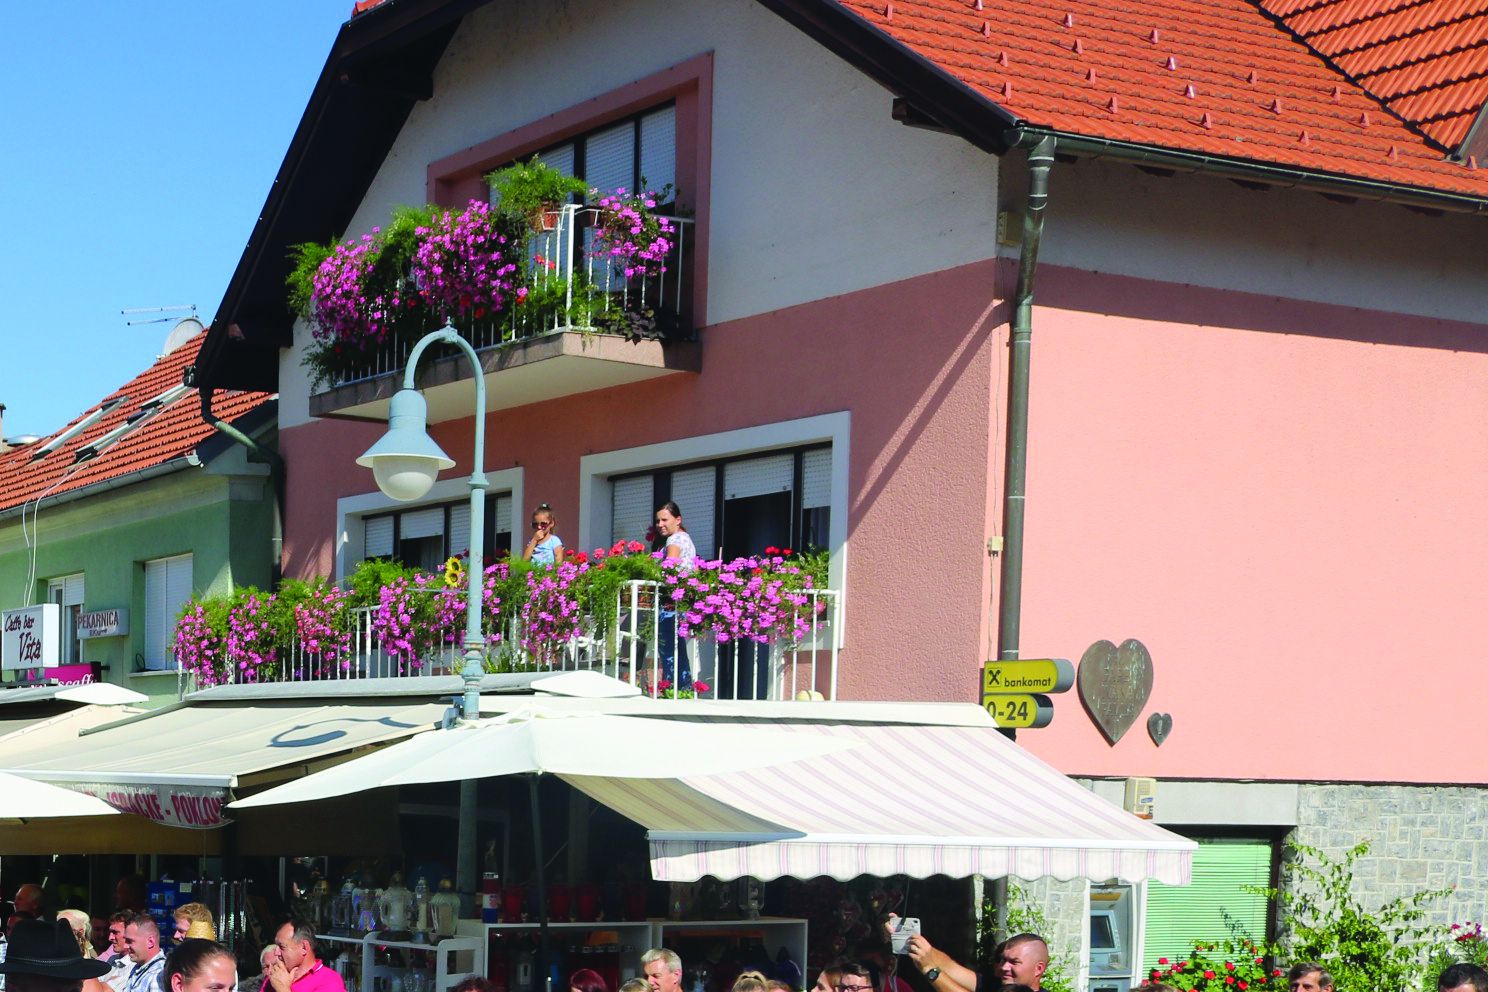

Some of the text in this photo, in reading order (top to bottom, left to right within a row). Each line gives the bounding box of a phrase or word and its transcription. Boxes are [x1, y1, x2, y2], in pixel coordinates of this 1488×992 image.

[4, 613, 35, 633] Caffe bar
[77, 610, 119, 629] PEKARNICA
[19, 632, 42, 664] Vita
[1004, 677, 1051, 687] bankomat
[987, 701, 1028, 721] 0-24
